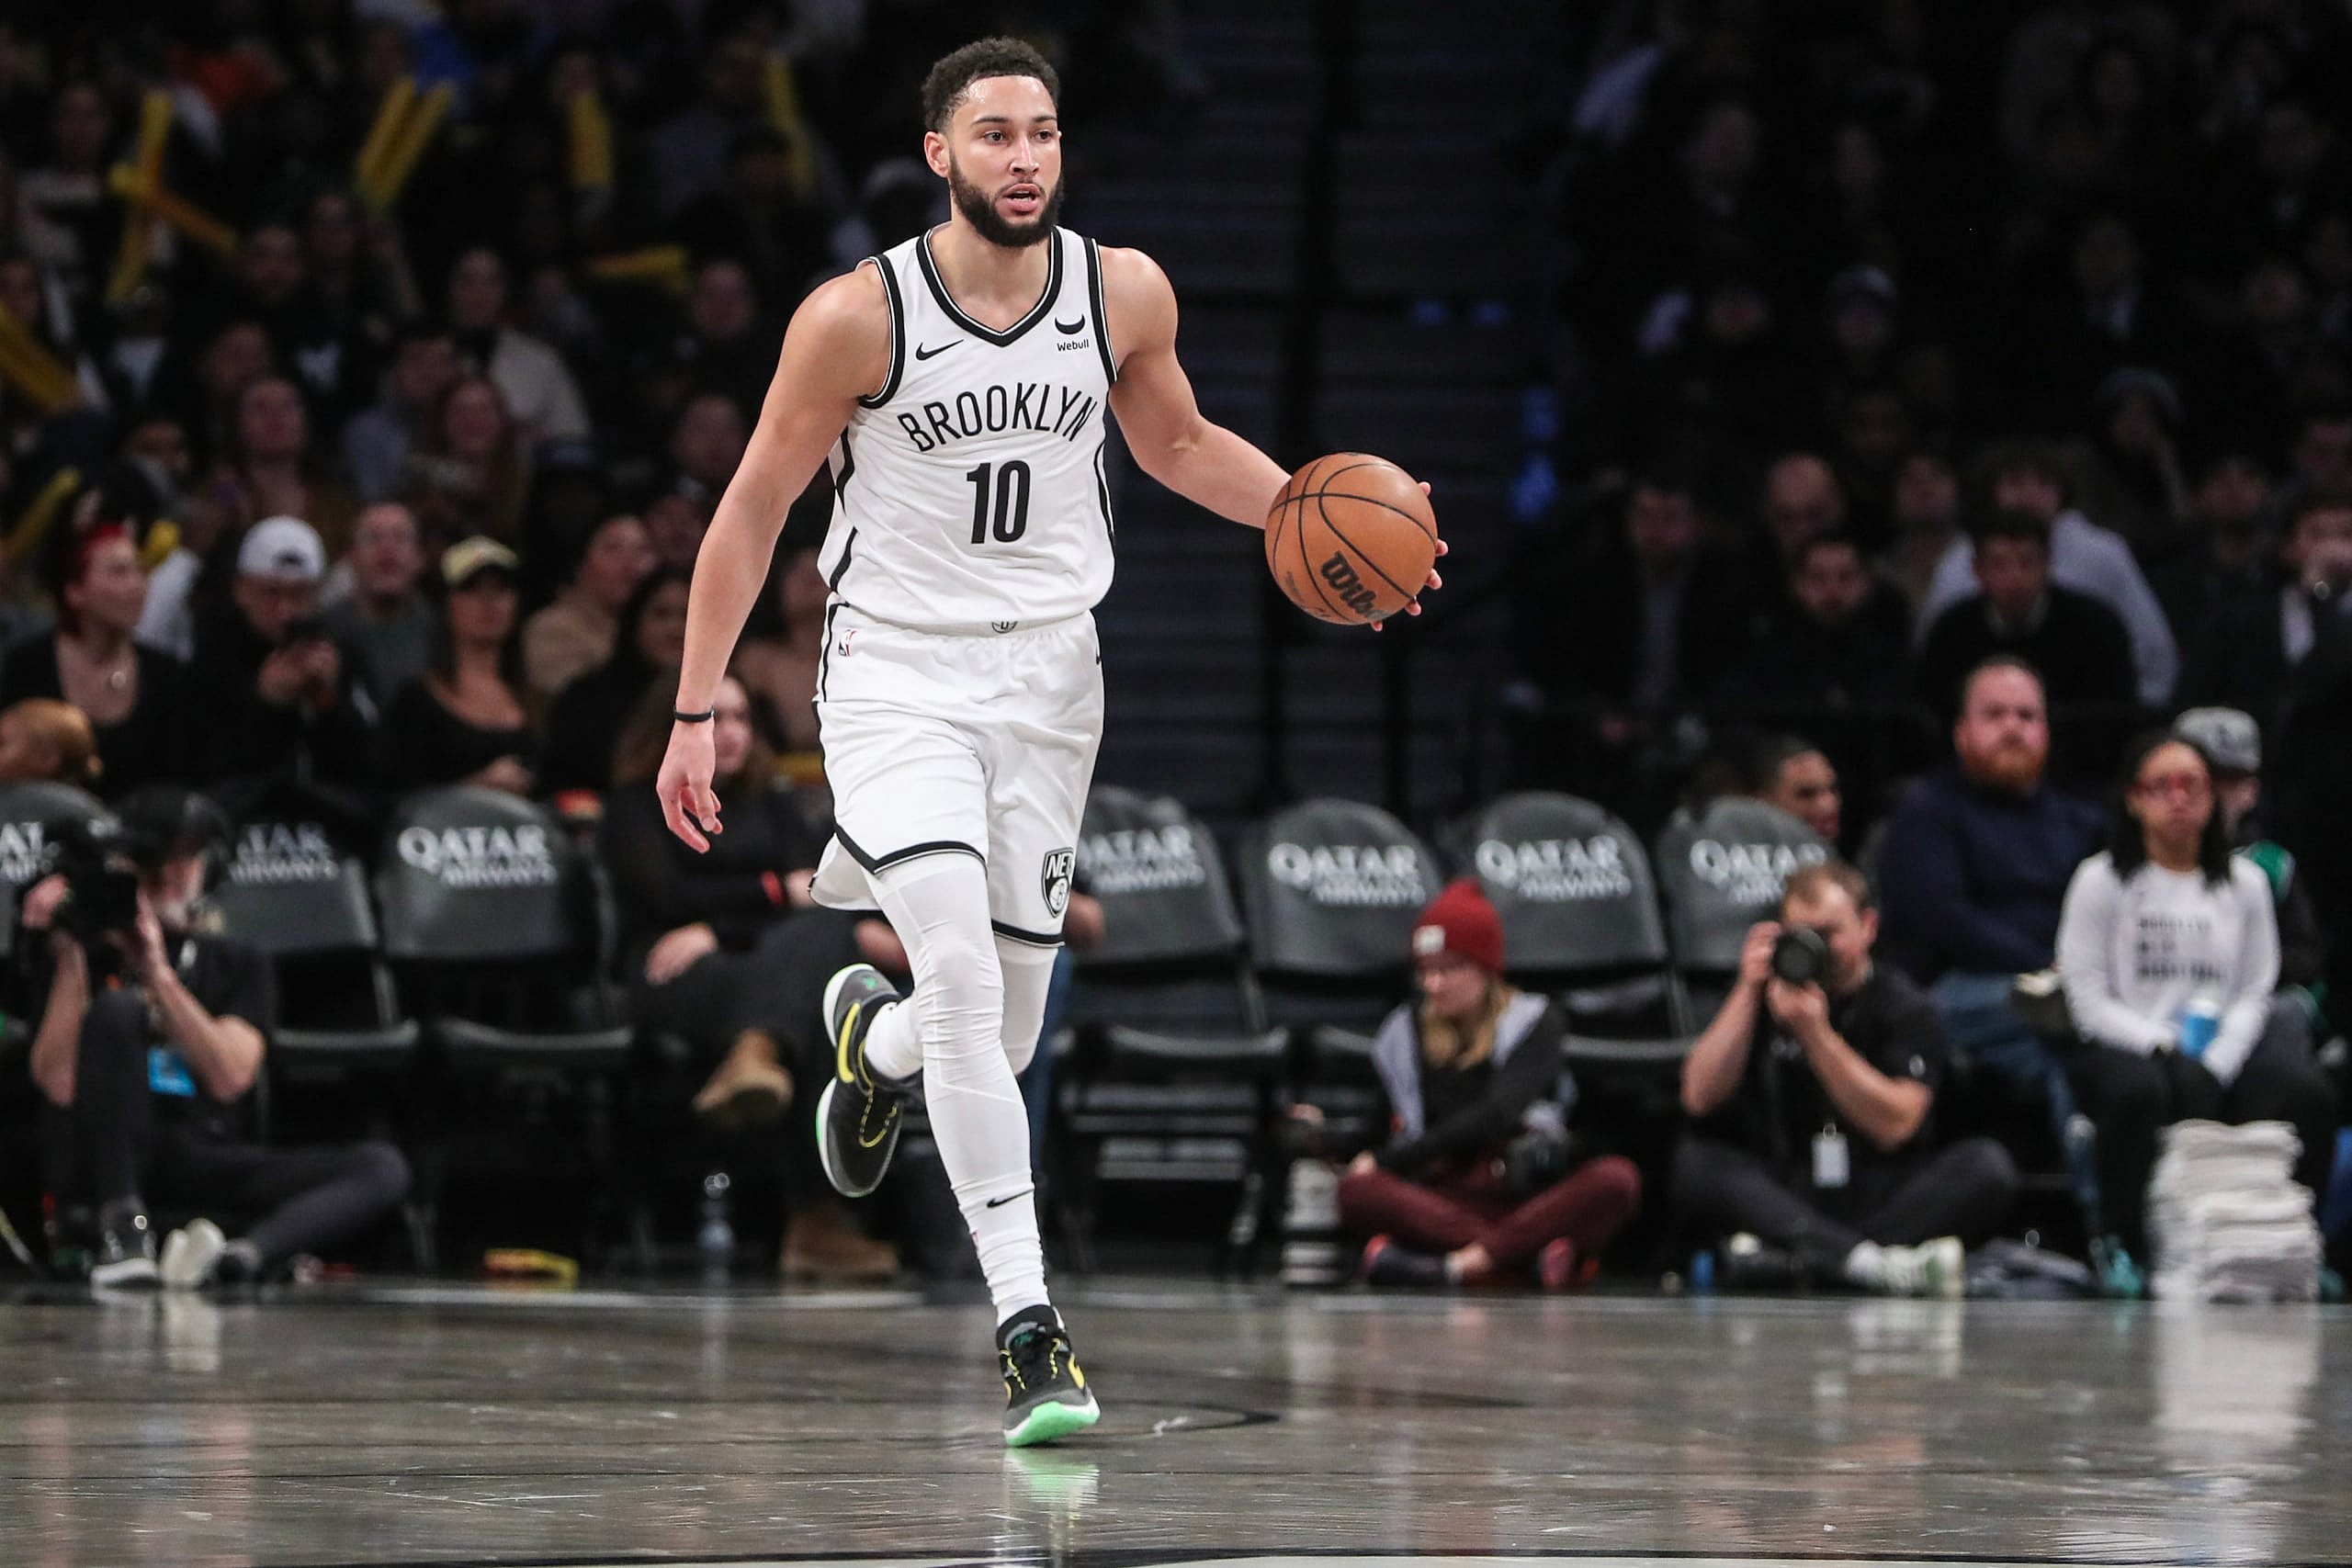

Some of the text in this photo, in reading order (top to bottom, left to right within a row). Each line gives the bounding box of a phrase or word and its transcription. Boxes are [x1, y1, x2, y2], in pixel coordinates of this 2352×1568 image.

[1057, 339, 1090, 352] Webull
[897, 382, 1098, 453] BROOKLYN
[967, 459, 1031, 544] 10
[397, 825, 550, 873] QATAR
[1268, 843, 1422, 891] QATAR
[1476, 835, 1623, 888] QATAR
